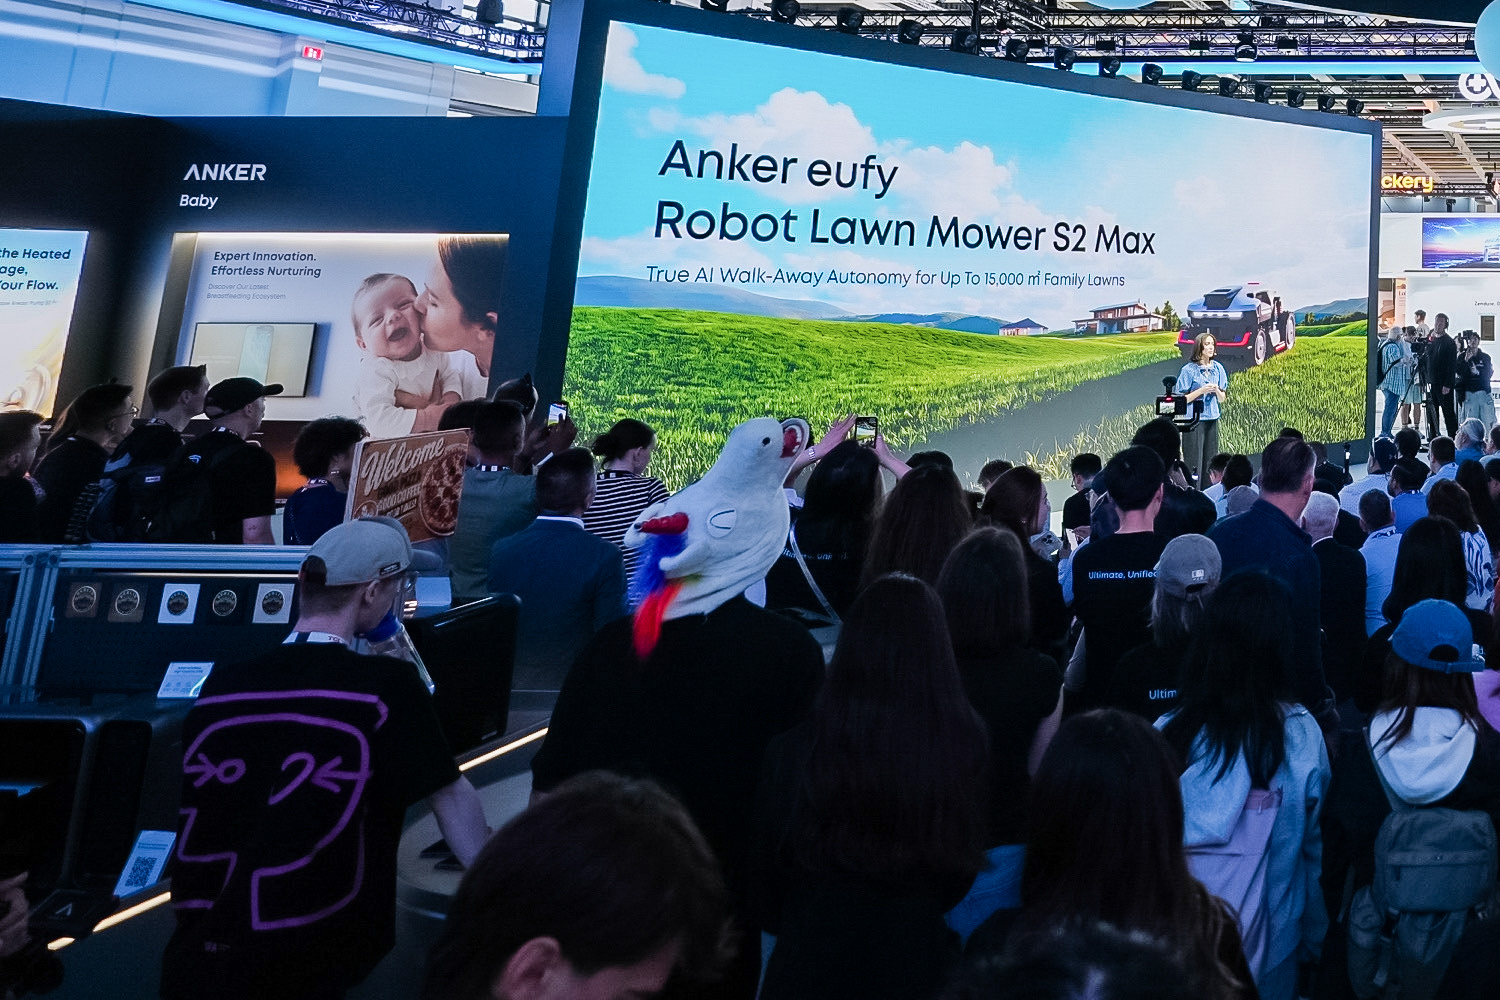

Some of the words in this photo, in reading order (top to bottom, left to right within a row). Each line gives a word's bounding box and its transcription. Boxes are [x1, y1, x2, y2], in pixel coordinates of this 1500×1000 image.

[183, 163, 267, 181] ANKER
[657, 139, 799, 184] Anker
[806, 154, 899, 200] eufy
[179, 193, 219, 210] Baby
[654, 200, 799, 243] Robot
[810, 208, 915, 247] Lawn
[926, 215, 1047, 251] Mower
[1052, 221, 1087, 253] S2
[1094, 224, 1156, 255] Max
[22, 248, 72, 260] Heated
[213, 251, 251, 263] Expert
[252, 251, 318, 262] Innovation.
[211, 265, 265, 277] Effortless
[267, 265, 322, 279] Nurturing
[646, 265, 690, 283] True
[694, 266, 714, 283] AI
[719, 267, 824, 288] Walk-Away
[826, 269, 912, 289] Autonomy
[915, 270, 938, 285] for
[940, 270, 961, 289] Up
[964, 271, 981, 286] To
[984, 272, 1024, 287] 15,000
[1044, 272, 1086, 289] Family
[1087, 273, 1126, 287] Lawns
[27, 280, 59, 291] Flow.
[361, 437, 445, 497] Welcome
